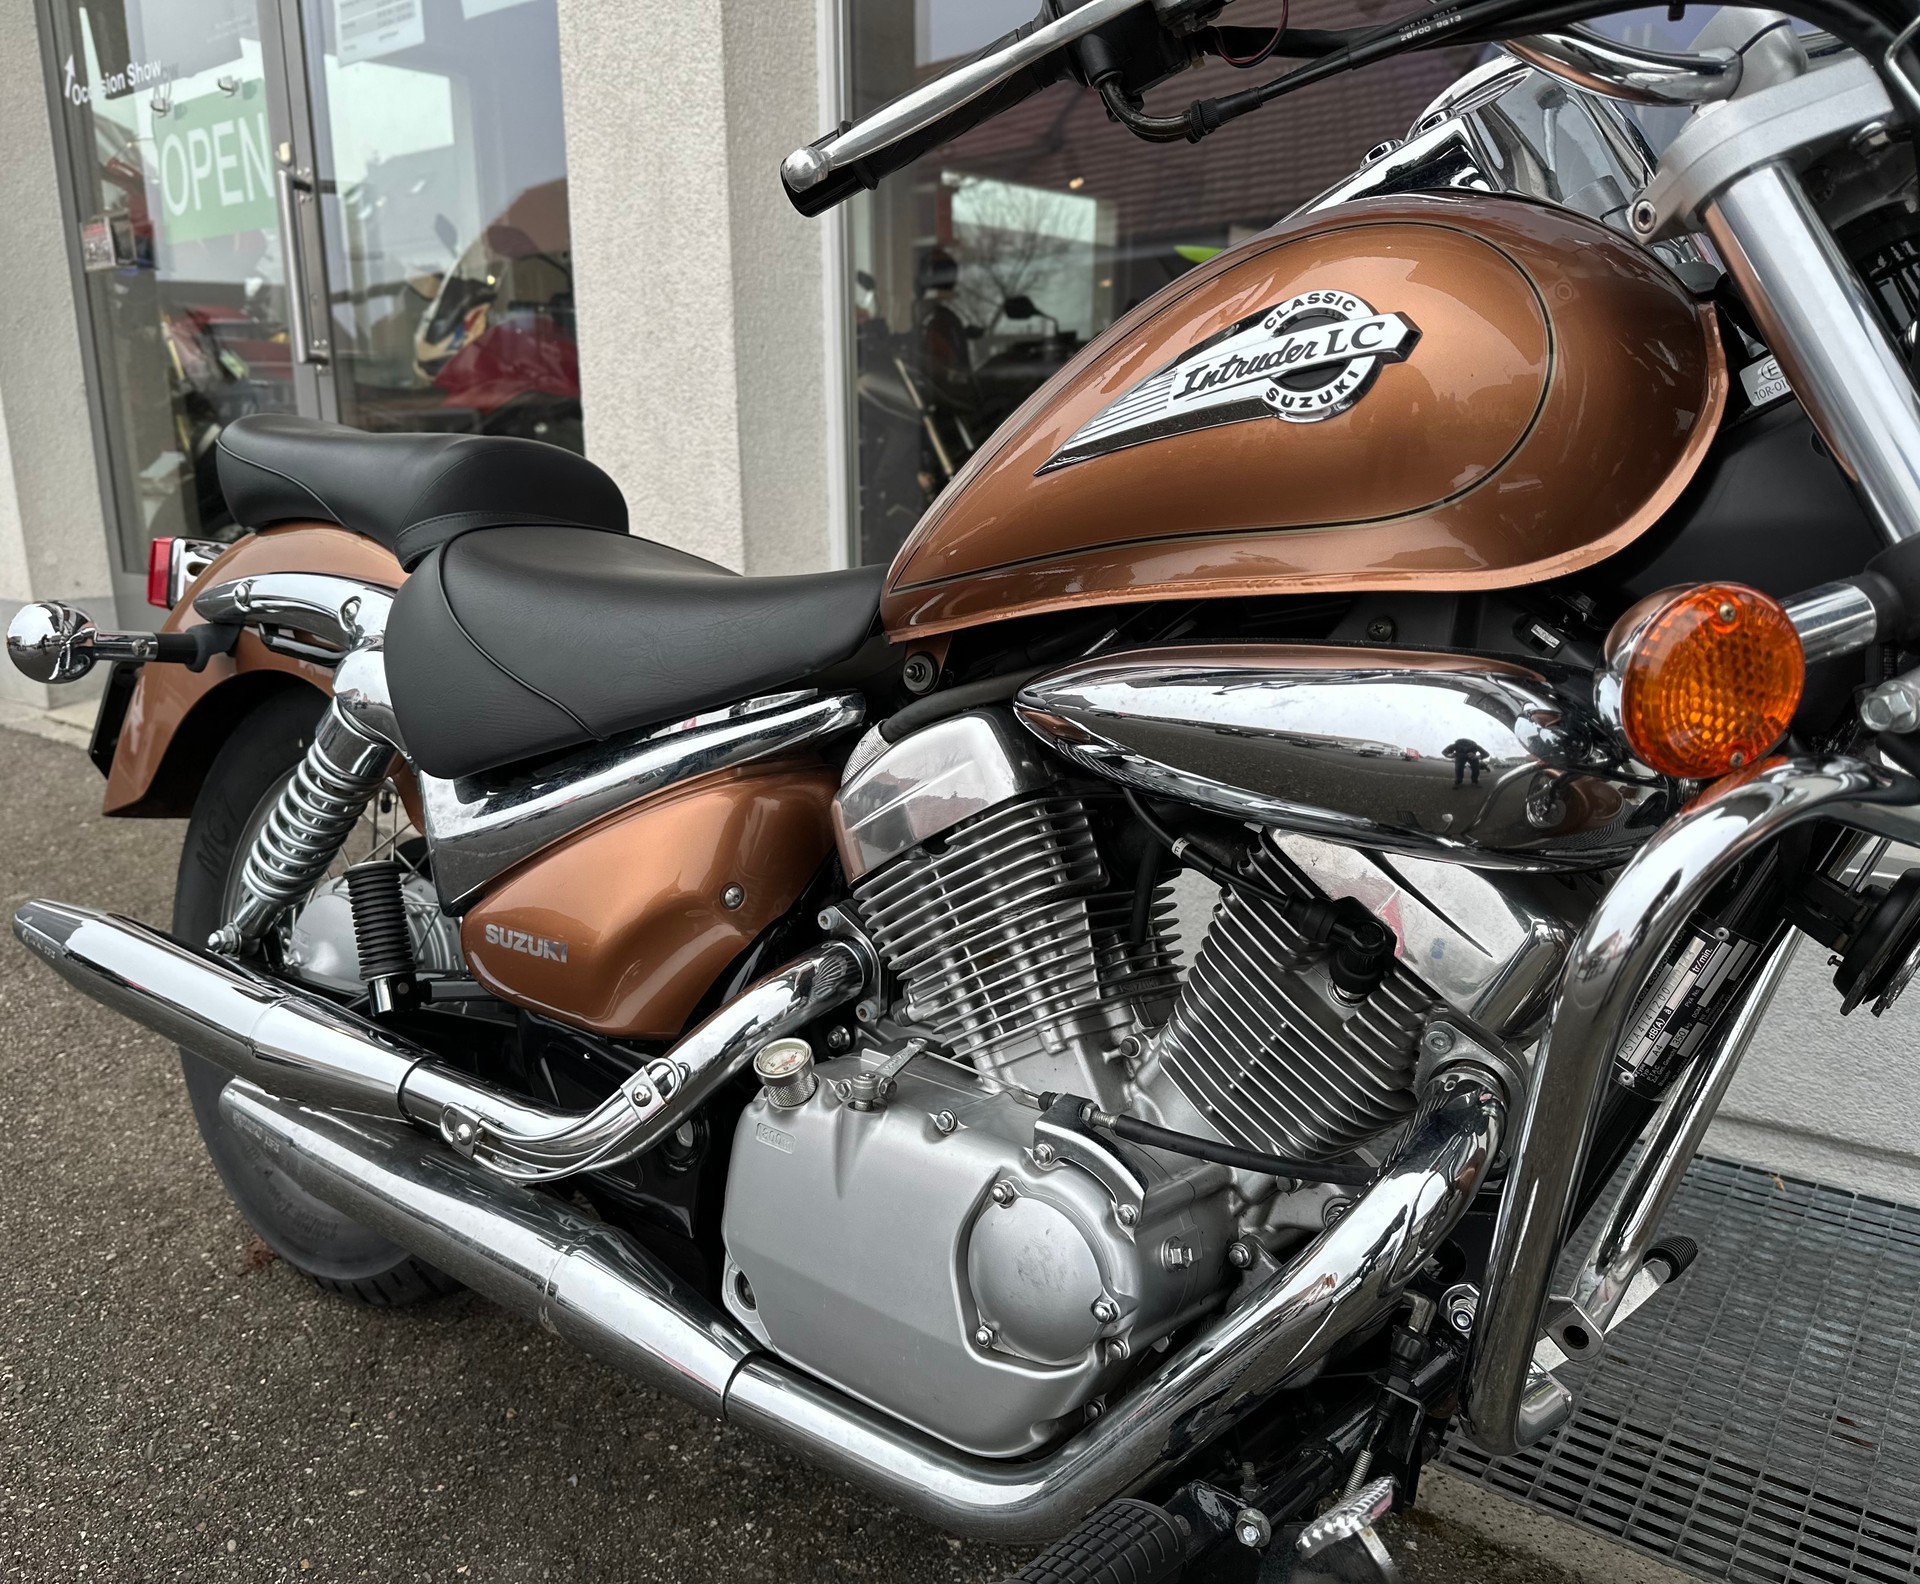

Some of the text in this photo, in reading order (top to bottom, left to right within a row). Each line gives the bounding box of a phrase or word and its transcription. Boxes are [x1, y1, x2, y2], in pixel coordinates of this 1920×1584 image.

[127, 60, 161, 87] Show
[161, 112, 275, 217] OPEN
[1263, 292, 1357, 331] CLASSIC
[1173, 321, 1386, 400] Intruder LC
[1265, 369, 1360, 409] SUZUKI
[484, 923, 569, 964] SUZUKI
[1647, 928, 1687, 985] CORPORATION
[1647, 1017, 1666, 1040] dB(A)
[1691, 945, 1713, 973] tr/min.
[1651, 1043, 1663, 1056] A4
[1672, 1029, 1686, 1046] 350
